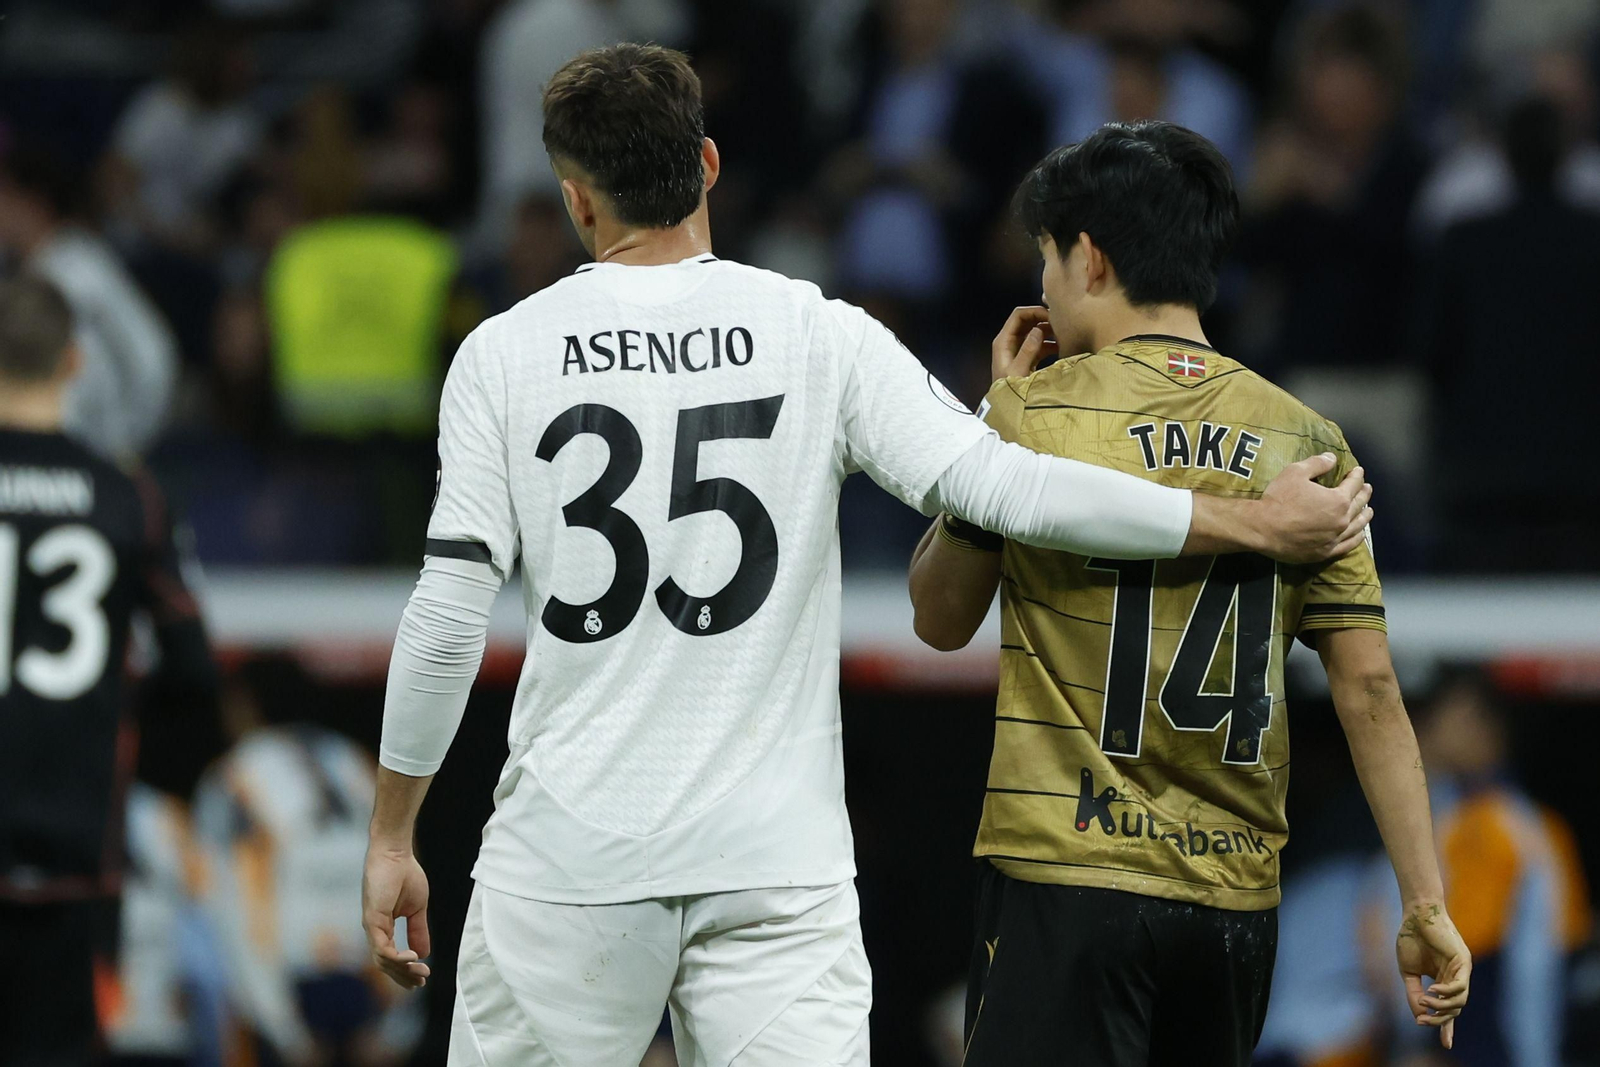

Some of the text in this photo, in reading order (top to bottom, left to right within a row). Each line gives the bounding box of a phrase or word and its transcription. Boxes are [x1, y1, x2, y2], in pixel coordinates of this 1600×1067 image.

[562, 327, 754, 376] ASENCIO
[1127, 421, 1263, 480] TAKE
[535, 393, 785, 644] 35
[1084, 551, 1277, 765] 14
[1075, 767, 1274, 857] Kutabank
